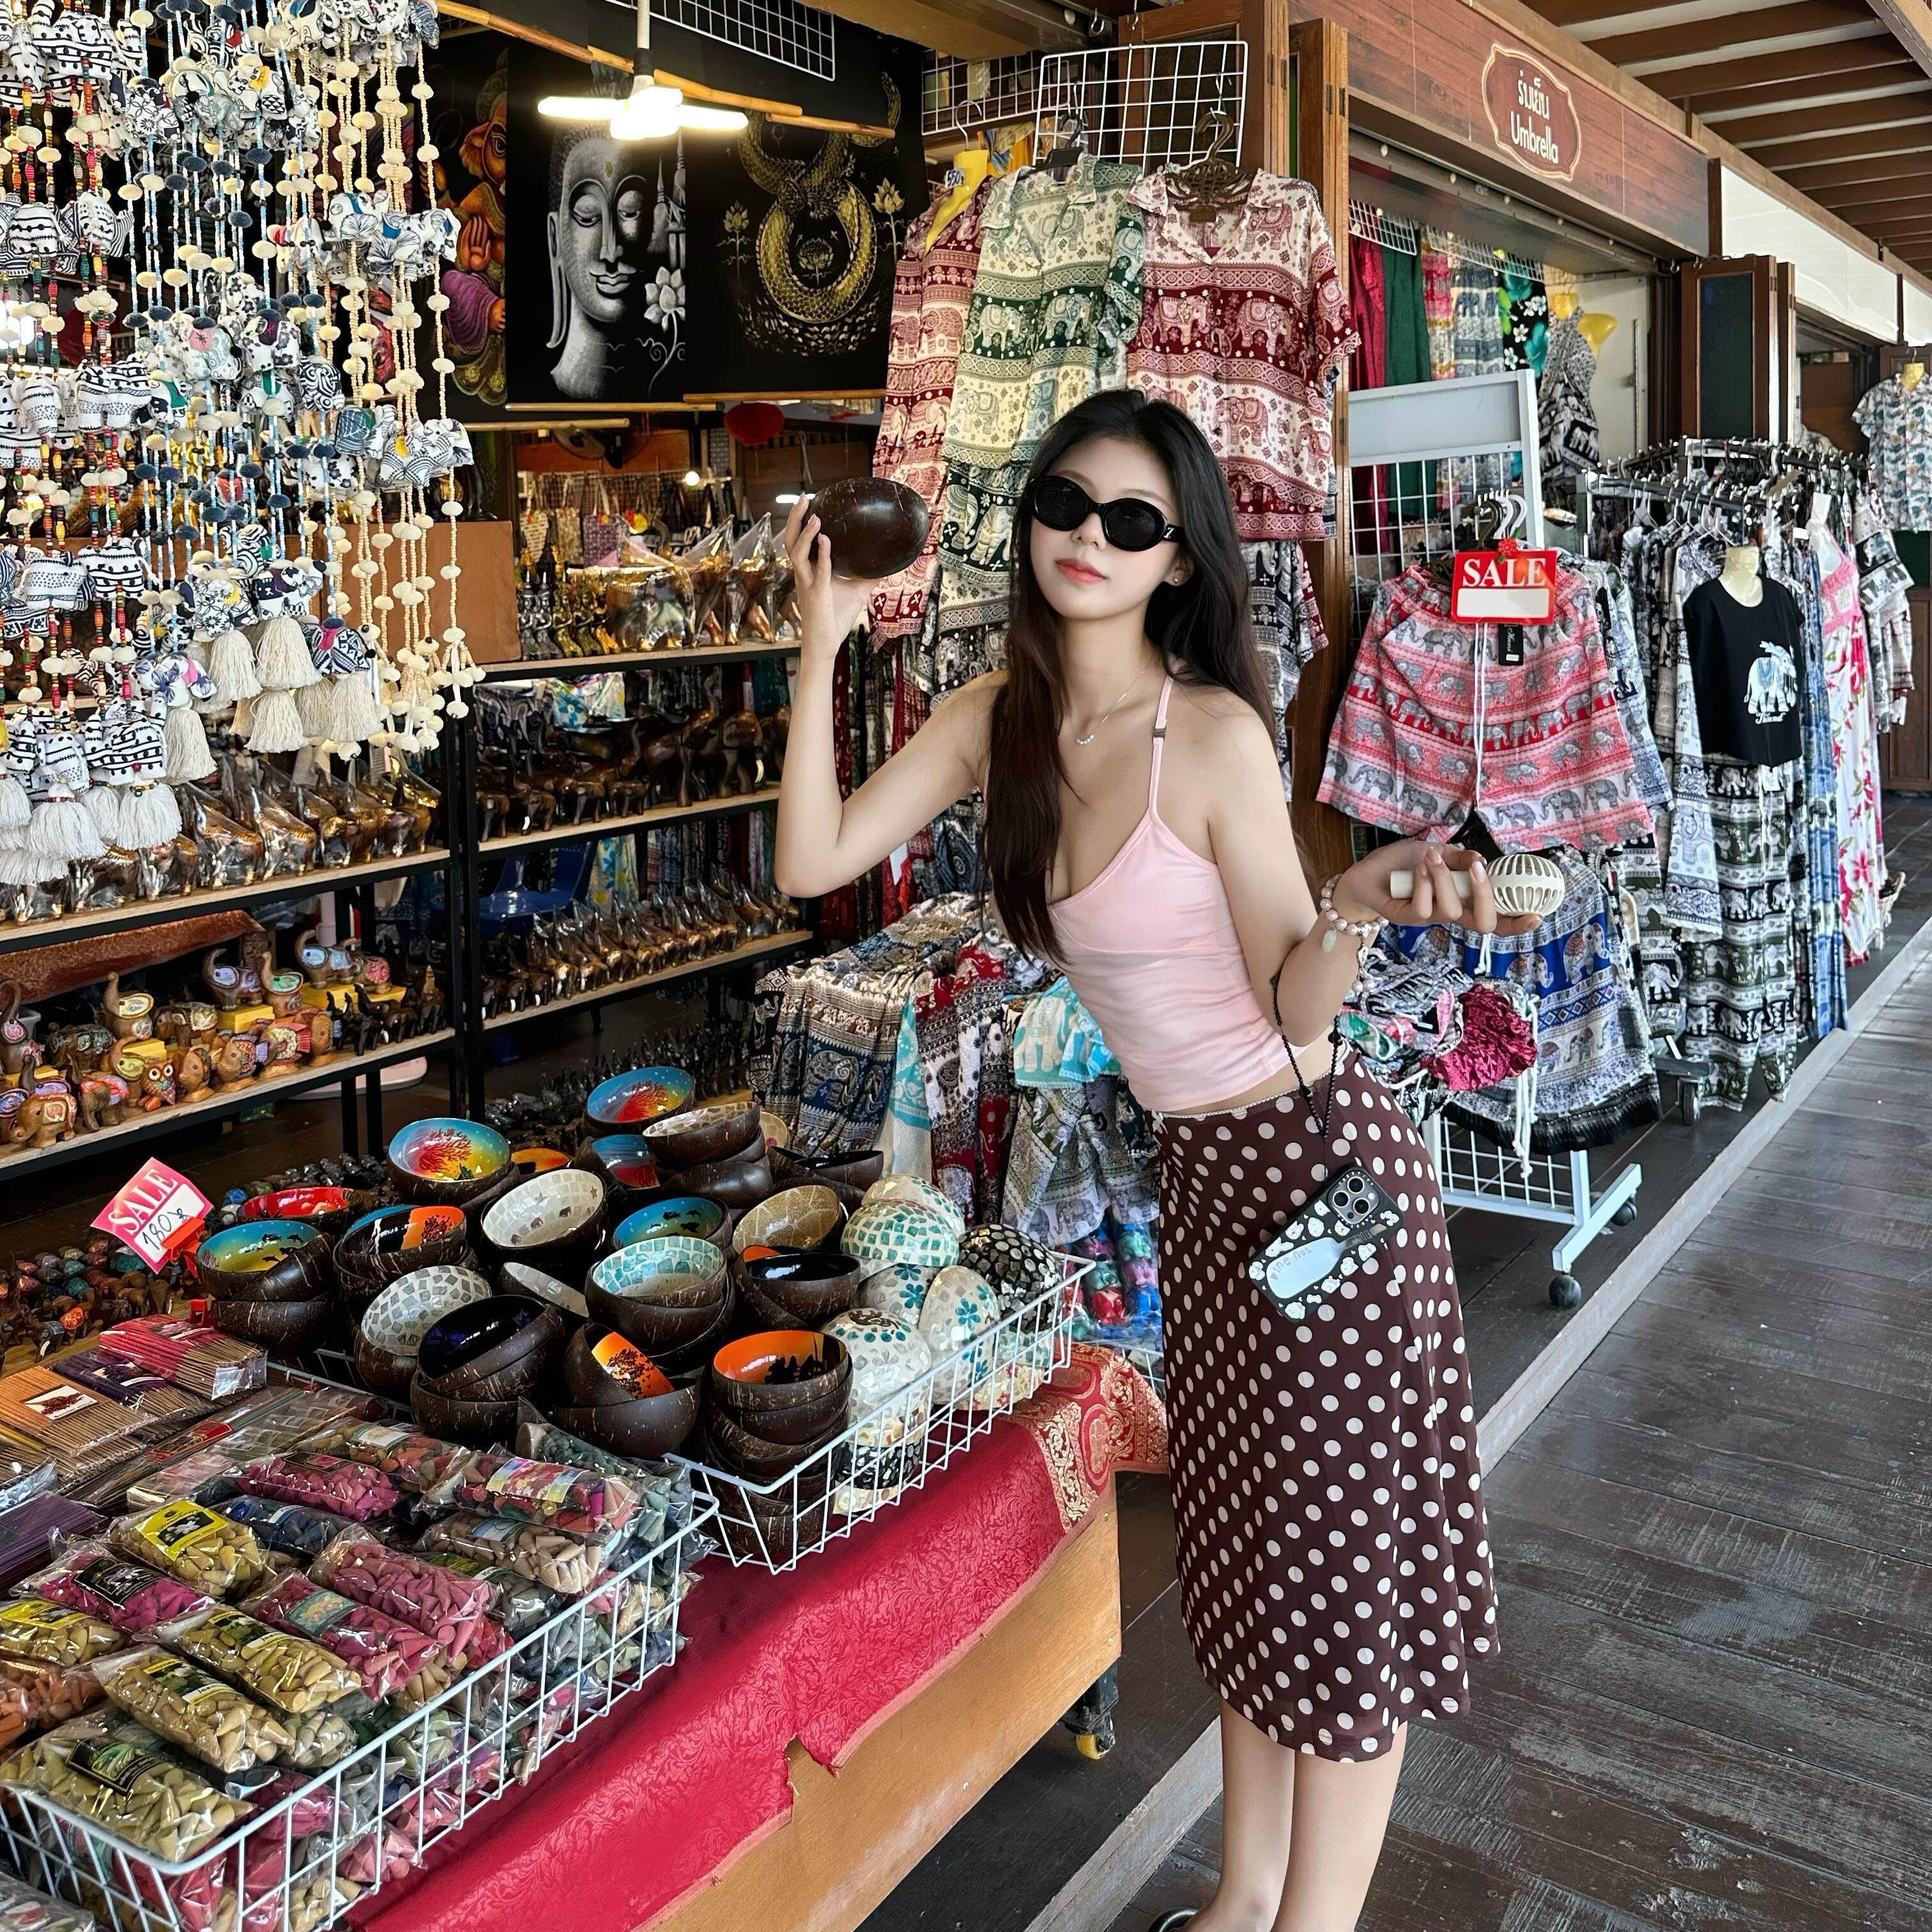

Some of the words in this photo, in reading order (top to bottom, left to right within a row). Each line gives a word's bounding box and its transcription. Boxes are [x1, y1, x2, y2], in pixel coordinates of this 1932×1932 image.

[1510, 111, 1558, 164] Umbrella
[1462, 558, 1545, 587] SALE
[108, 1169, 178, 1236] SALE
[1293, 1246, 1312, 1261] not
